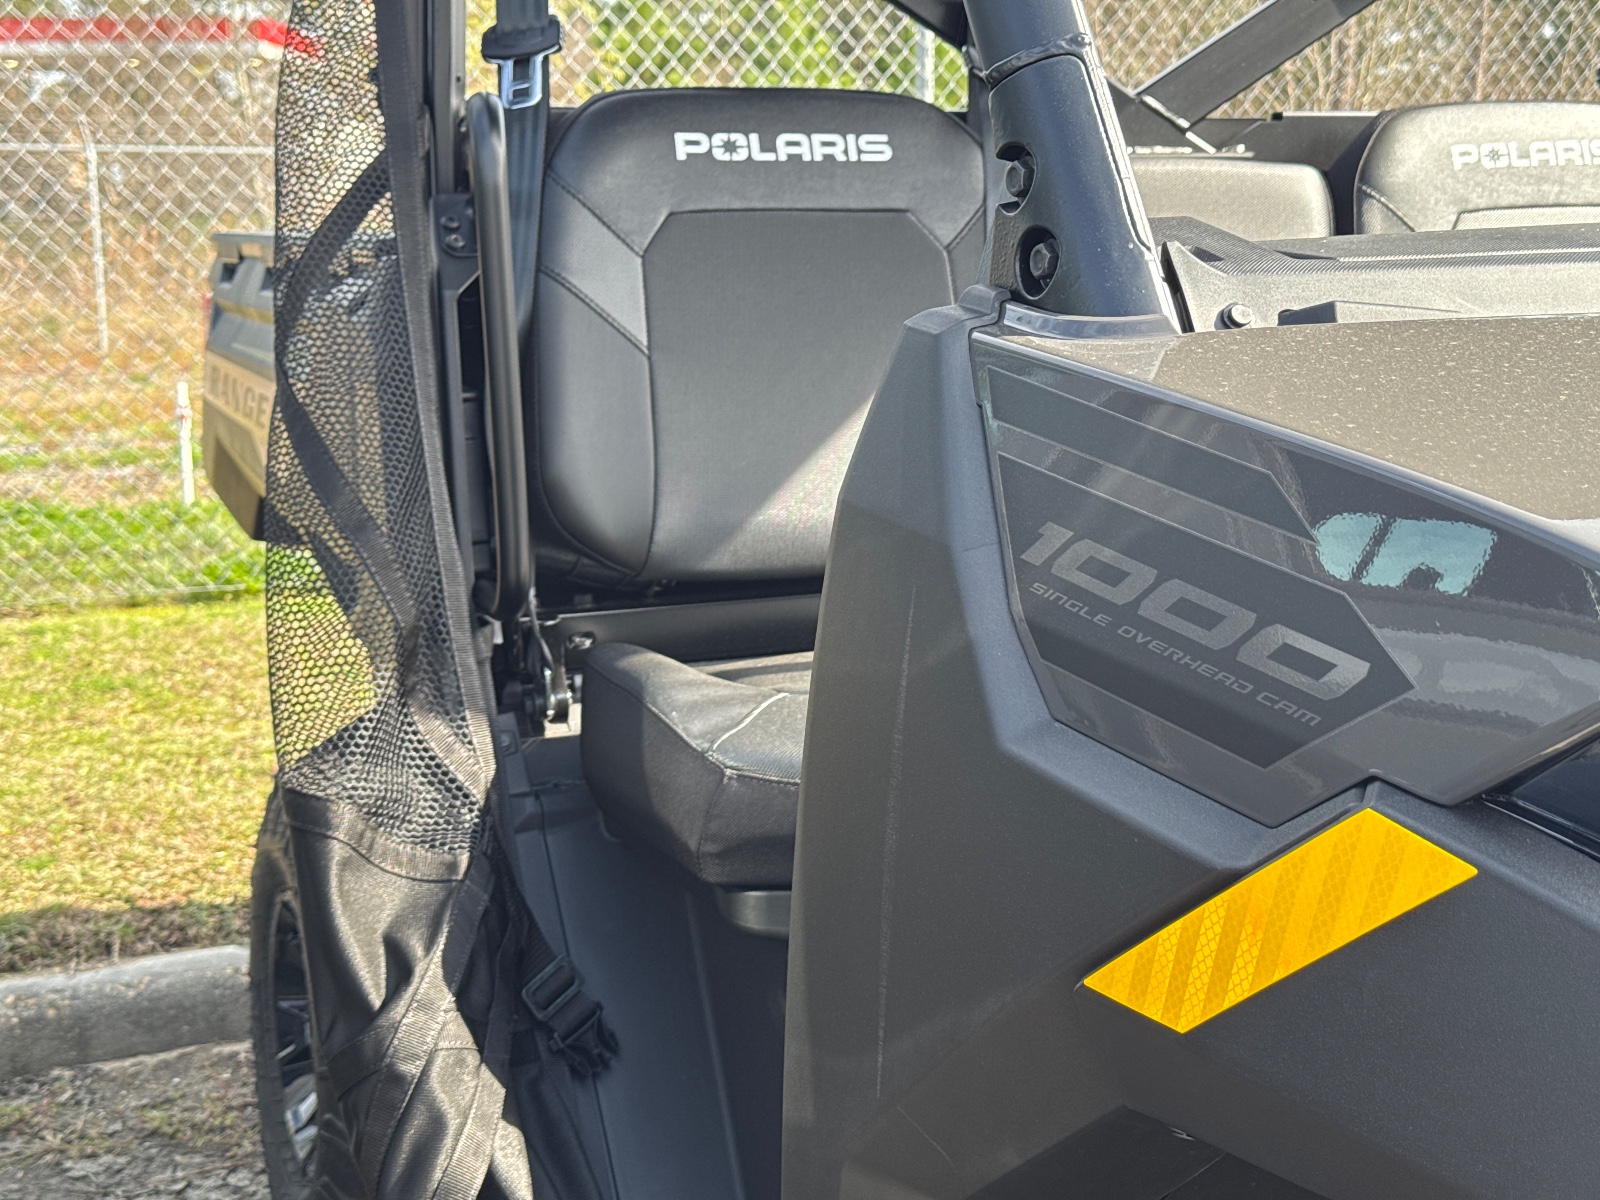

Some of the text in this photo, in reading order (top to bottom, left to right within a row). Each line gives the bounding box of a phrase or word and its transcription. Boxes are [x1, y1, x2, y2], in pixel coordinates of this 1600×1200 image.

[674, 132, 893, 162] POLARIS
[1020, 521, 1371, 700] 1000
[1029, 582, 1322, 726] SINGLE OVERHEAD CAM
